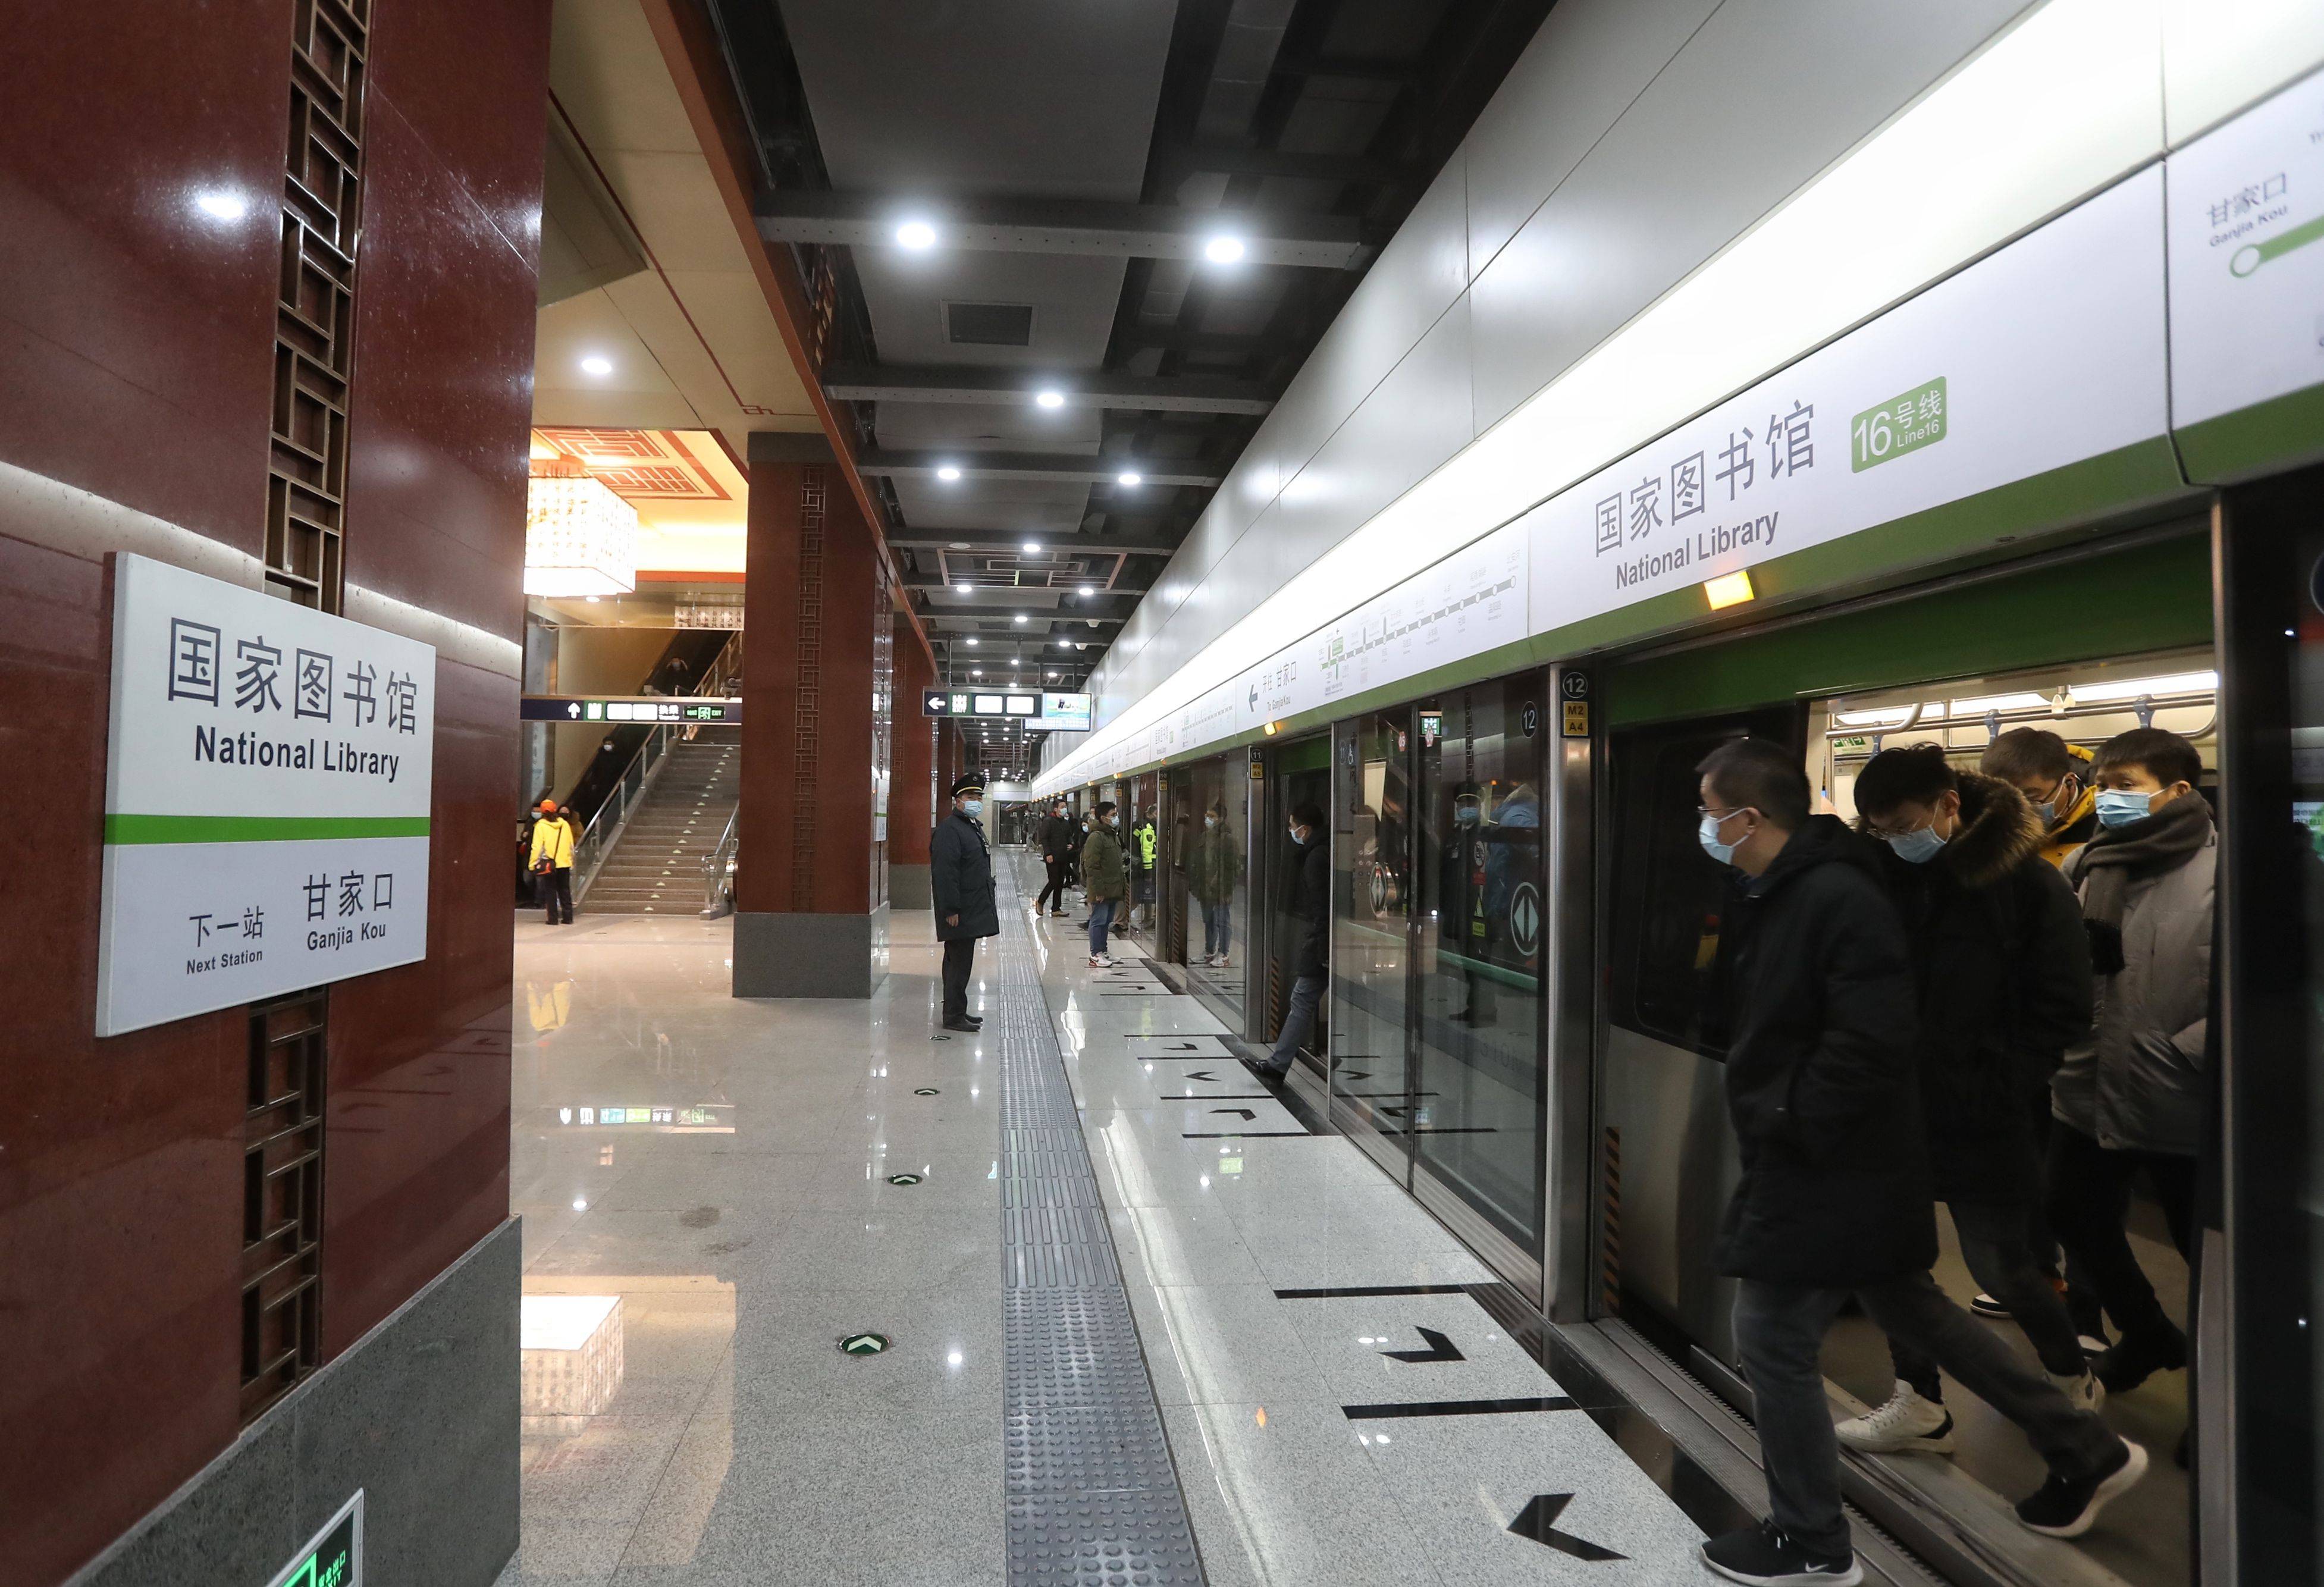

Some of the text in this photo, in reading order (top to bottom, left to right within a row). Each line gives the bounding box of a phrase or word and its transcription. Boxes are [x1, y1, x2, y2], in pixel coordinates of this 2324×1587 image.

[2206, 172, 2287, 228] 甘家口
[2209, 204, 2288, 247] Ganjia Kou
[1595, 399, 1814, 557] 国家图书馆
[1616, 511, 1779, 589] National Library
[168, 617, 418, 735] 国家图书馆
[1566, 678, 1586, 692] 12
[1523, 710, 1535, 730] 12
[1568, 706, 1583, 715] M2
[1569, 723, 1583, 732] A4
[195, 724, 400, 783] National Library
[303, 870, 393, 923] 甘家口
[189, 906, 265, 948] 下一站
[307, 921, 387, 955] Ganjia Kou
[187, 949, 264, 975] Next Station
